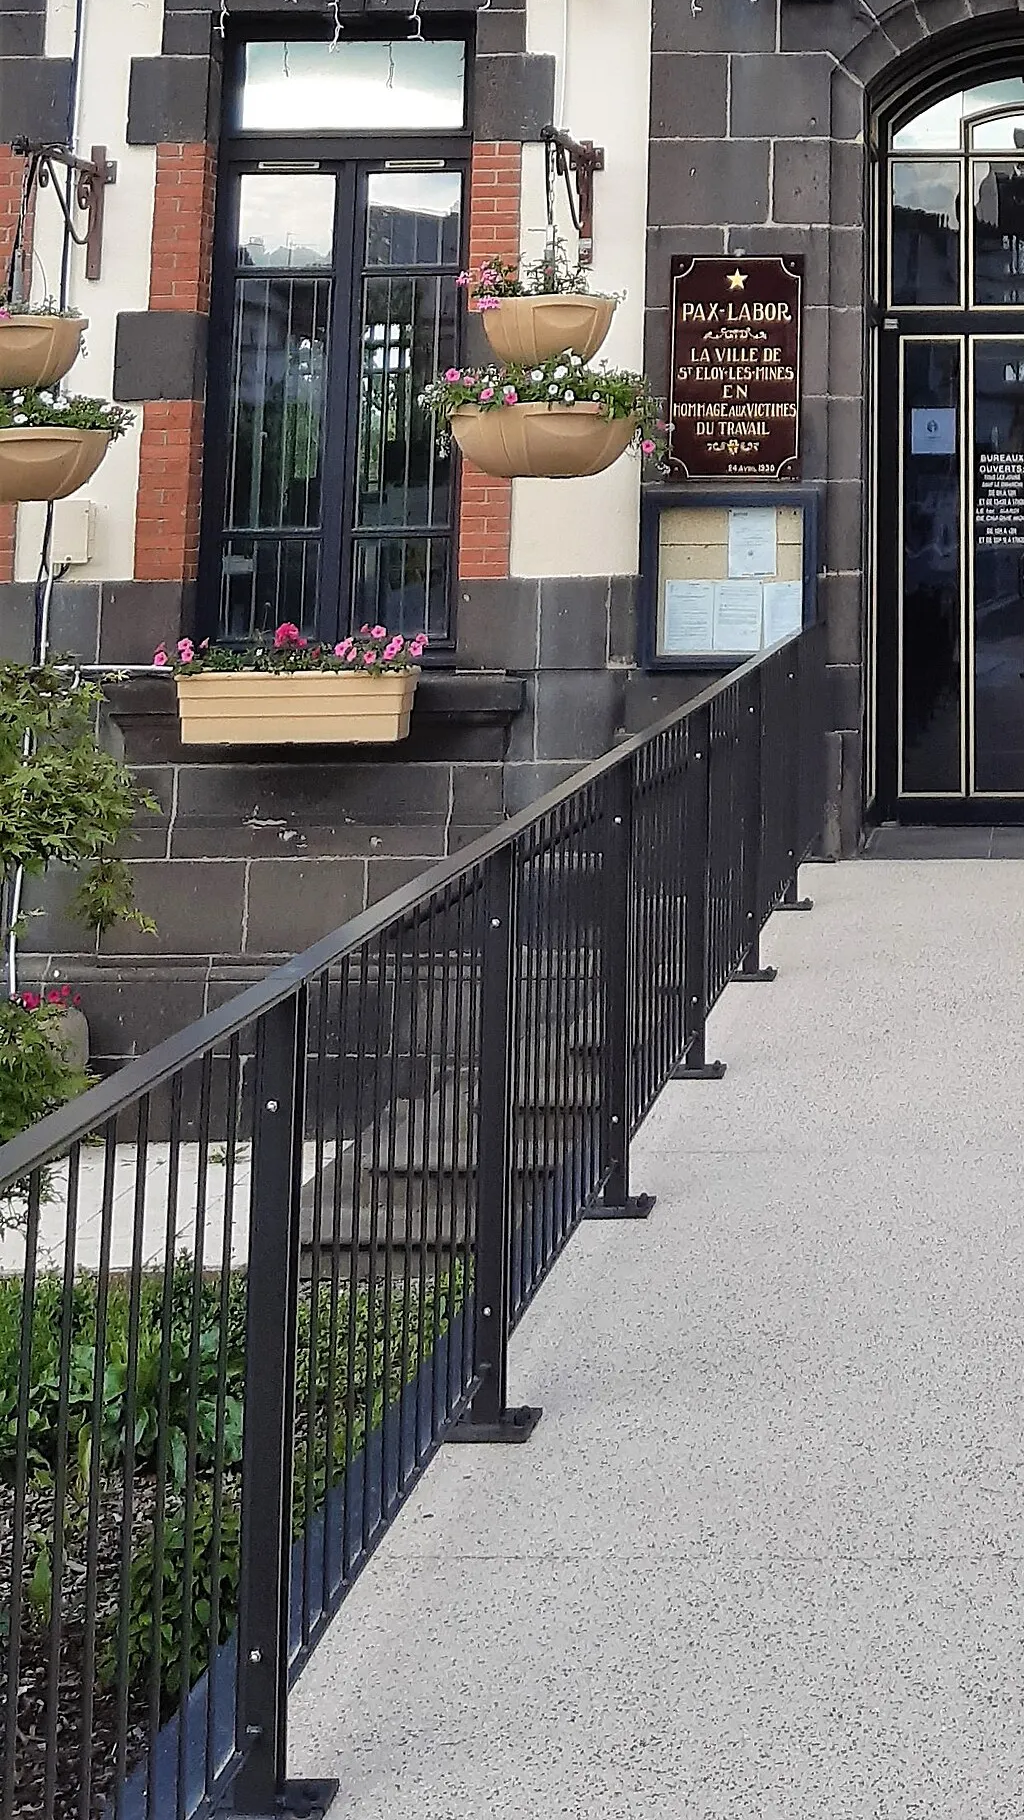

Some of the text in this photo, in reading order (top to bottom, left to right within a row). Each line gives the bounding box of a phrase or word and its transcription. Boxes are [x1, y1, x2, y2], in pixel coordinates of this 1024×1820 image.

[682, 302, 792, 321] PAX-LABOR
[691, 347, 782, 362] LA VILLE DE
[723, 384, 748, 399] EN
[673, 402, 797, 418] HOMMAGE AUX VICTIMES
[696, 421, 770, 436] DU TRAVAIL
[980, 454, 1024, 463] BUREAUX
